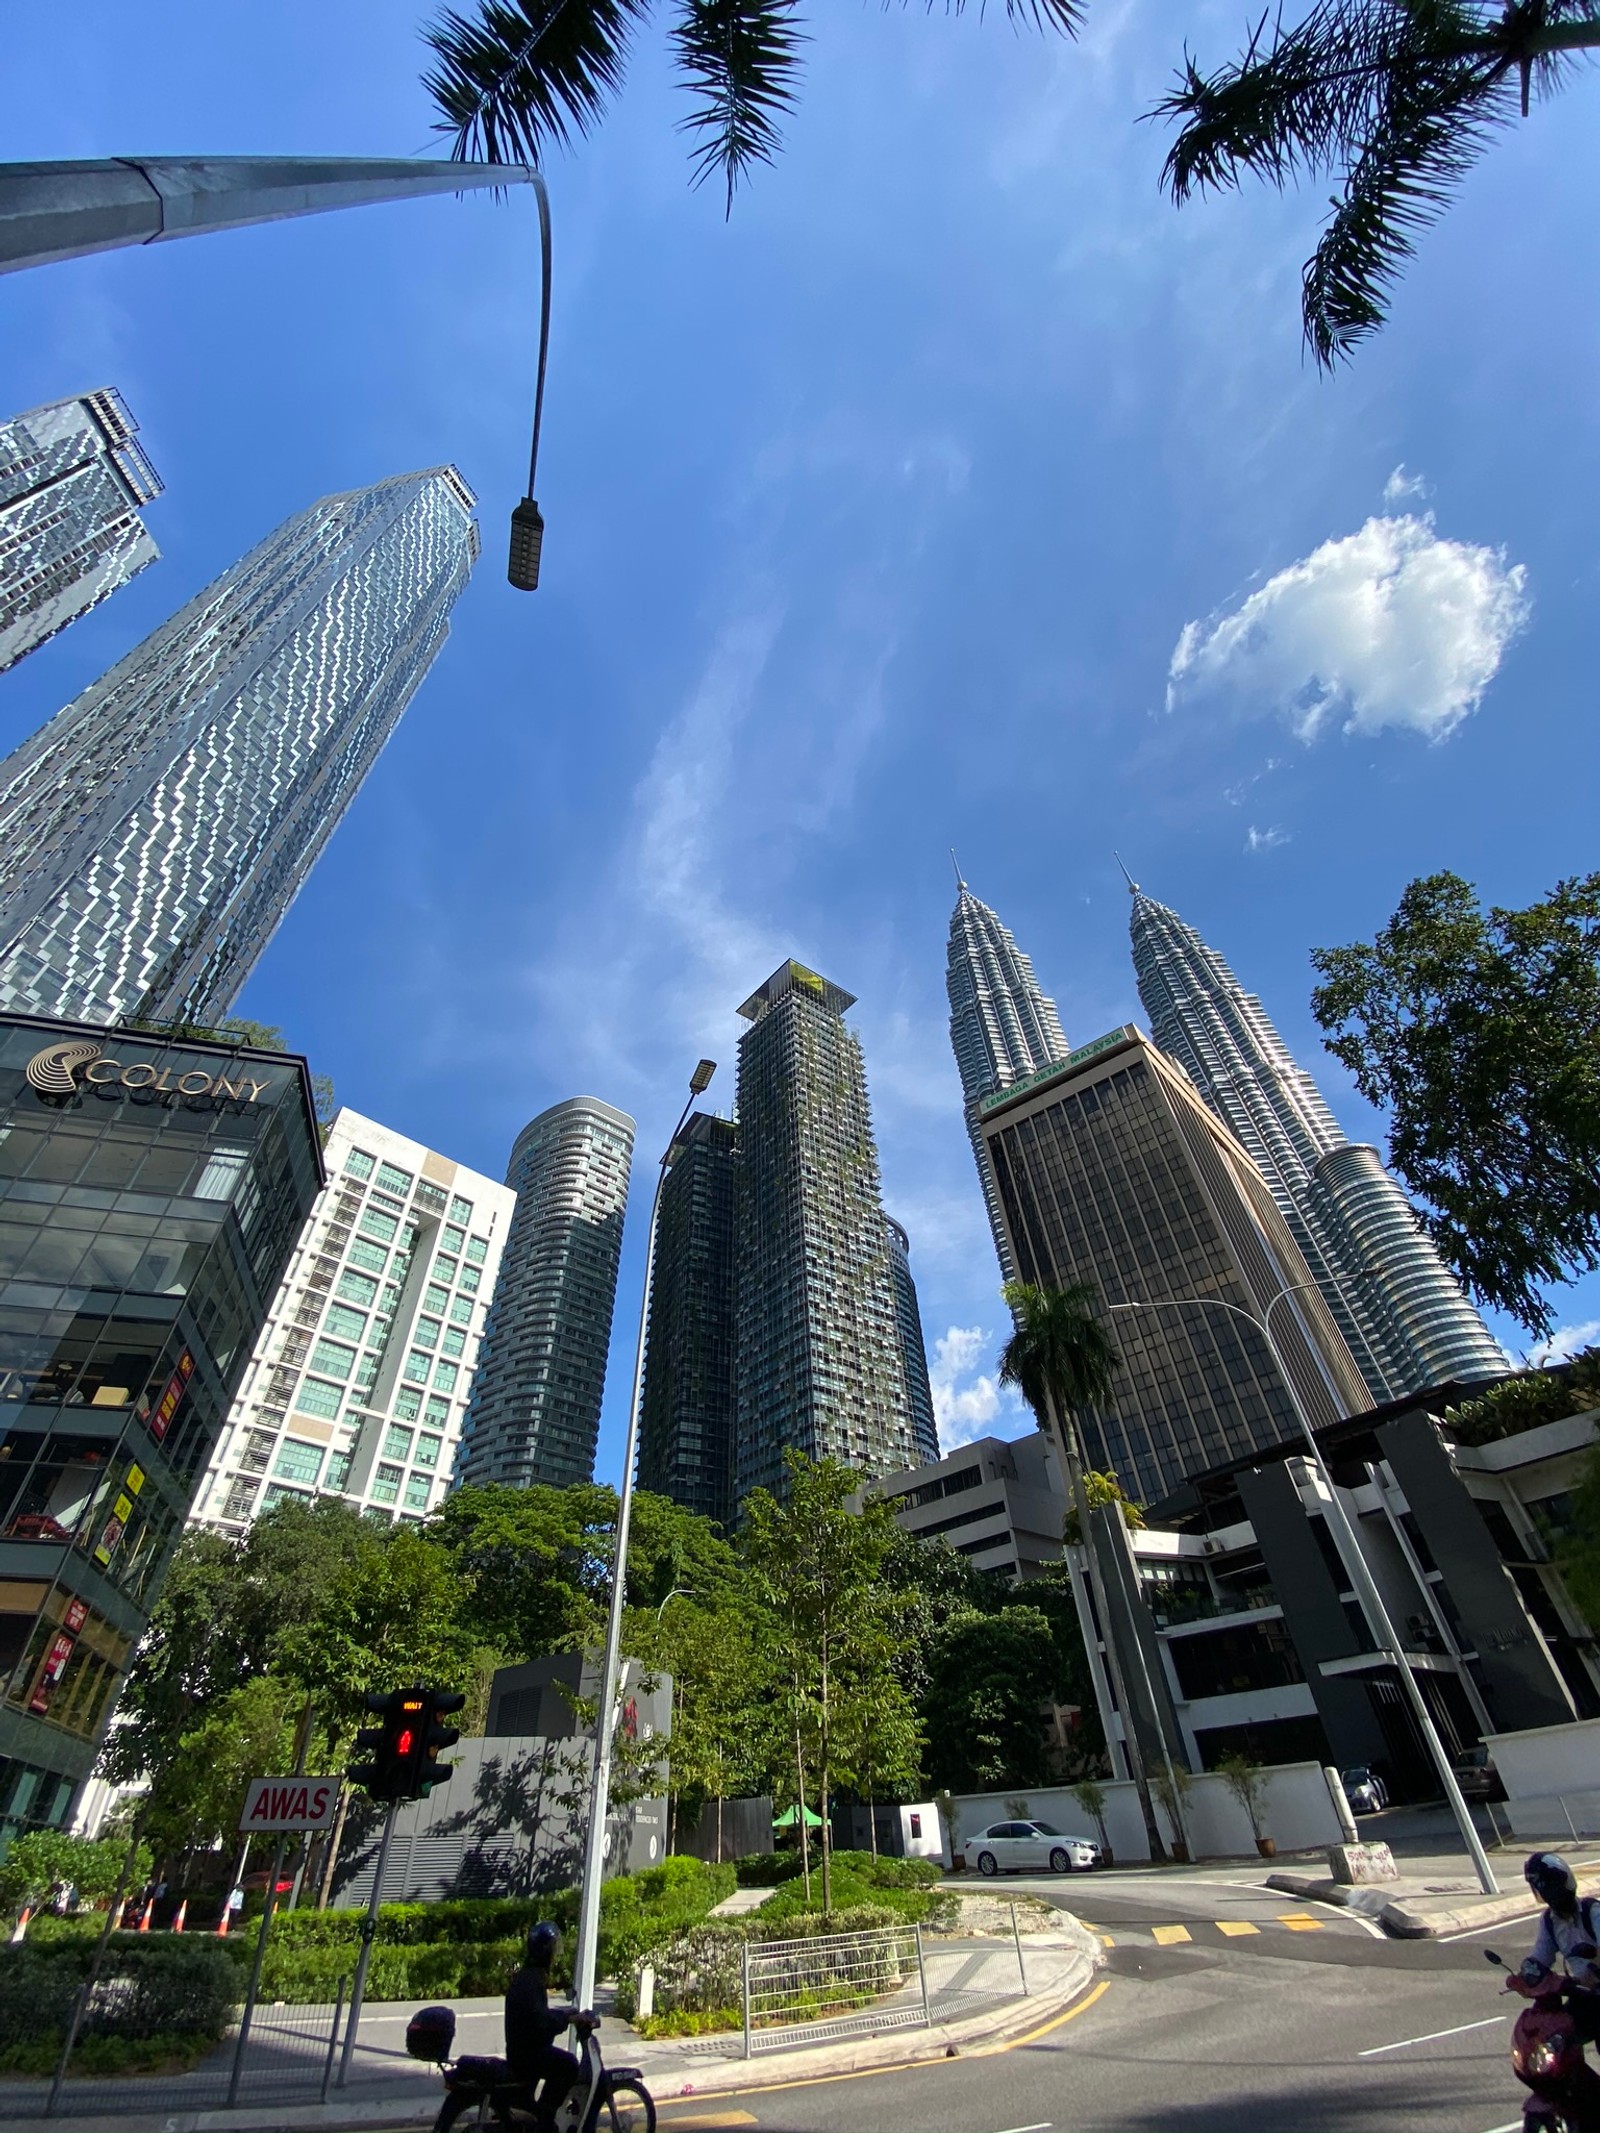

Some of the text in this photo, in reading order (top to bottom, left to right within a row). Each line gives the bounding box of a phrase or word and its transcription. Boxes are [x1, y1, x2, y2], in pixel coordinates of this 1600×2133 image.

[86, 1059, 271, 1101] COLONY
[986, 1033, 1123, 1108] LEMBAGA GETAH MALAYSIA
[404, 1702, 423, 1710] WAIT
[250, 1787, 330, 1820] AWAS
